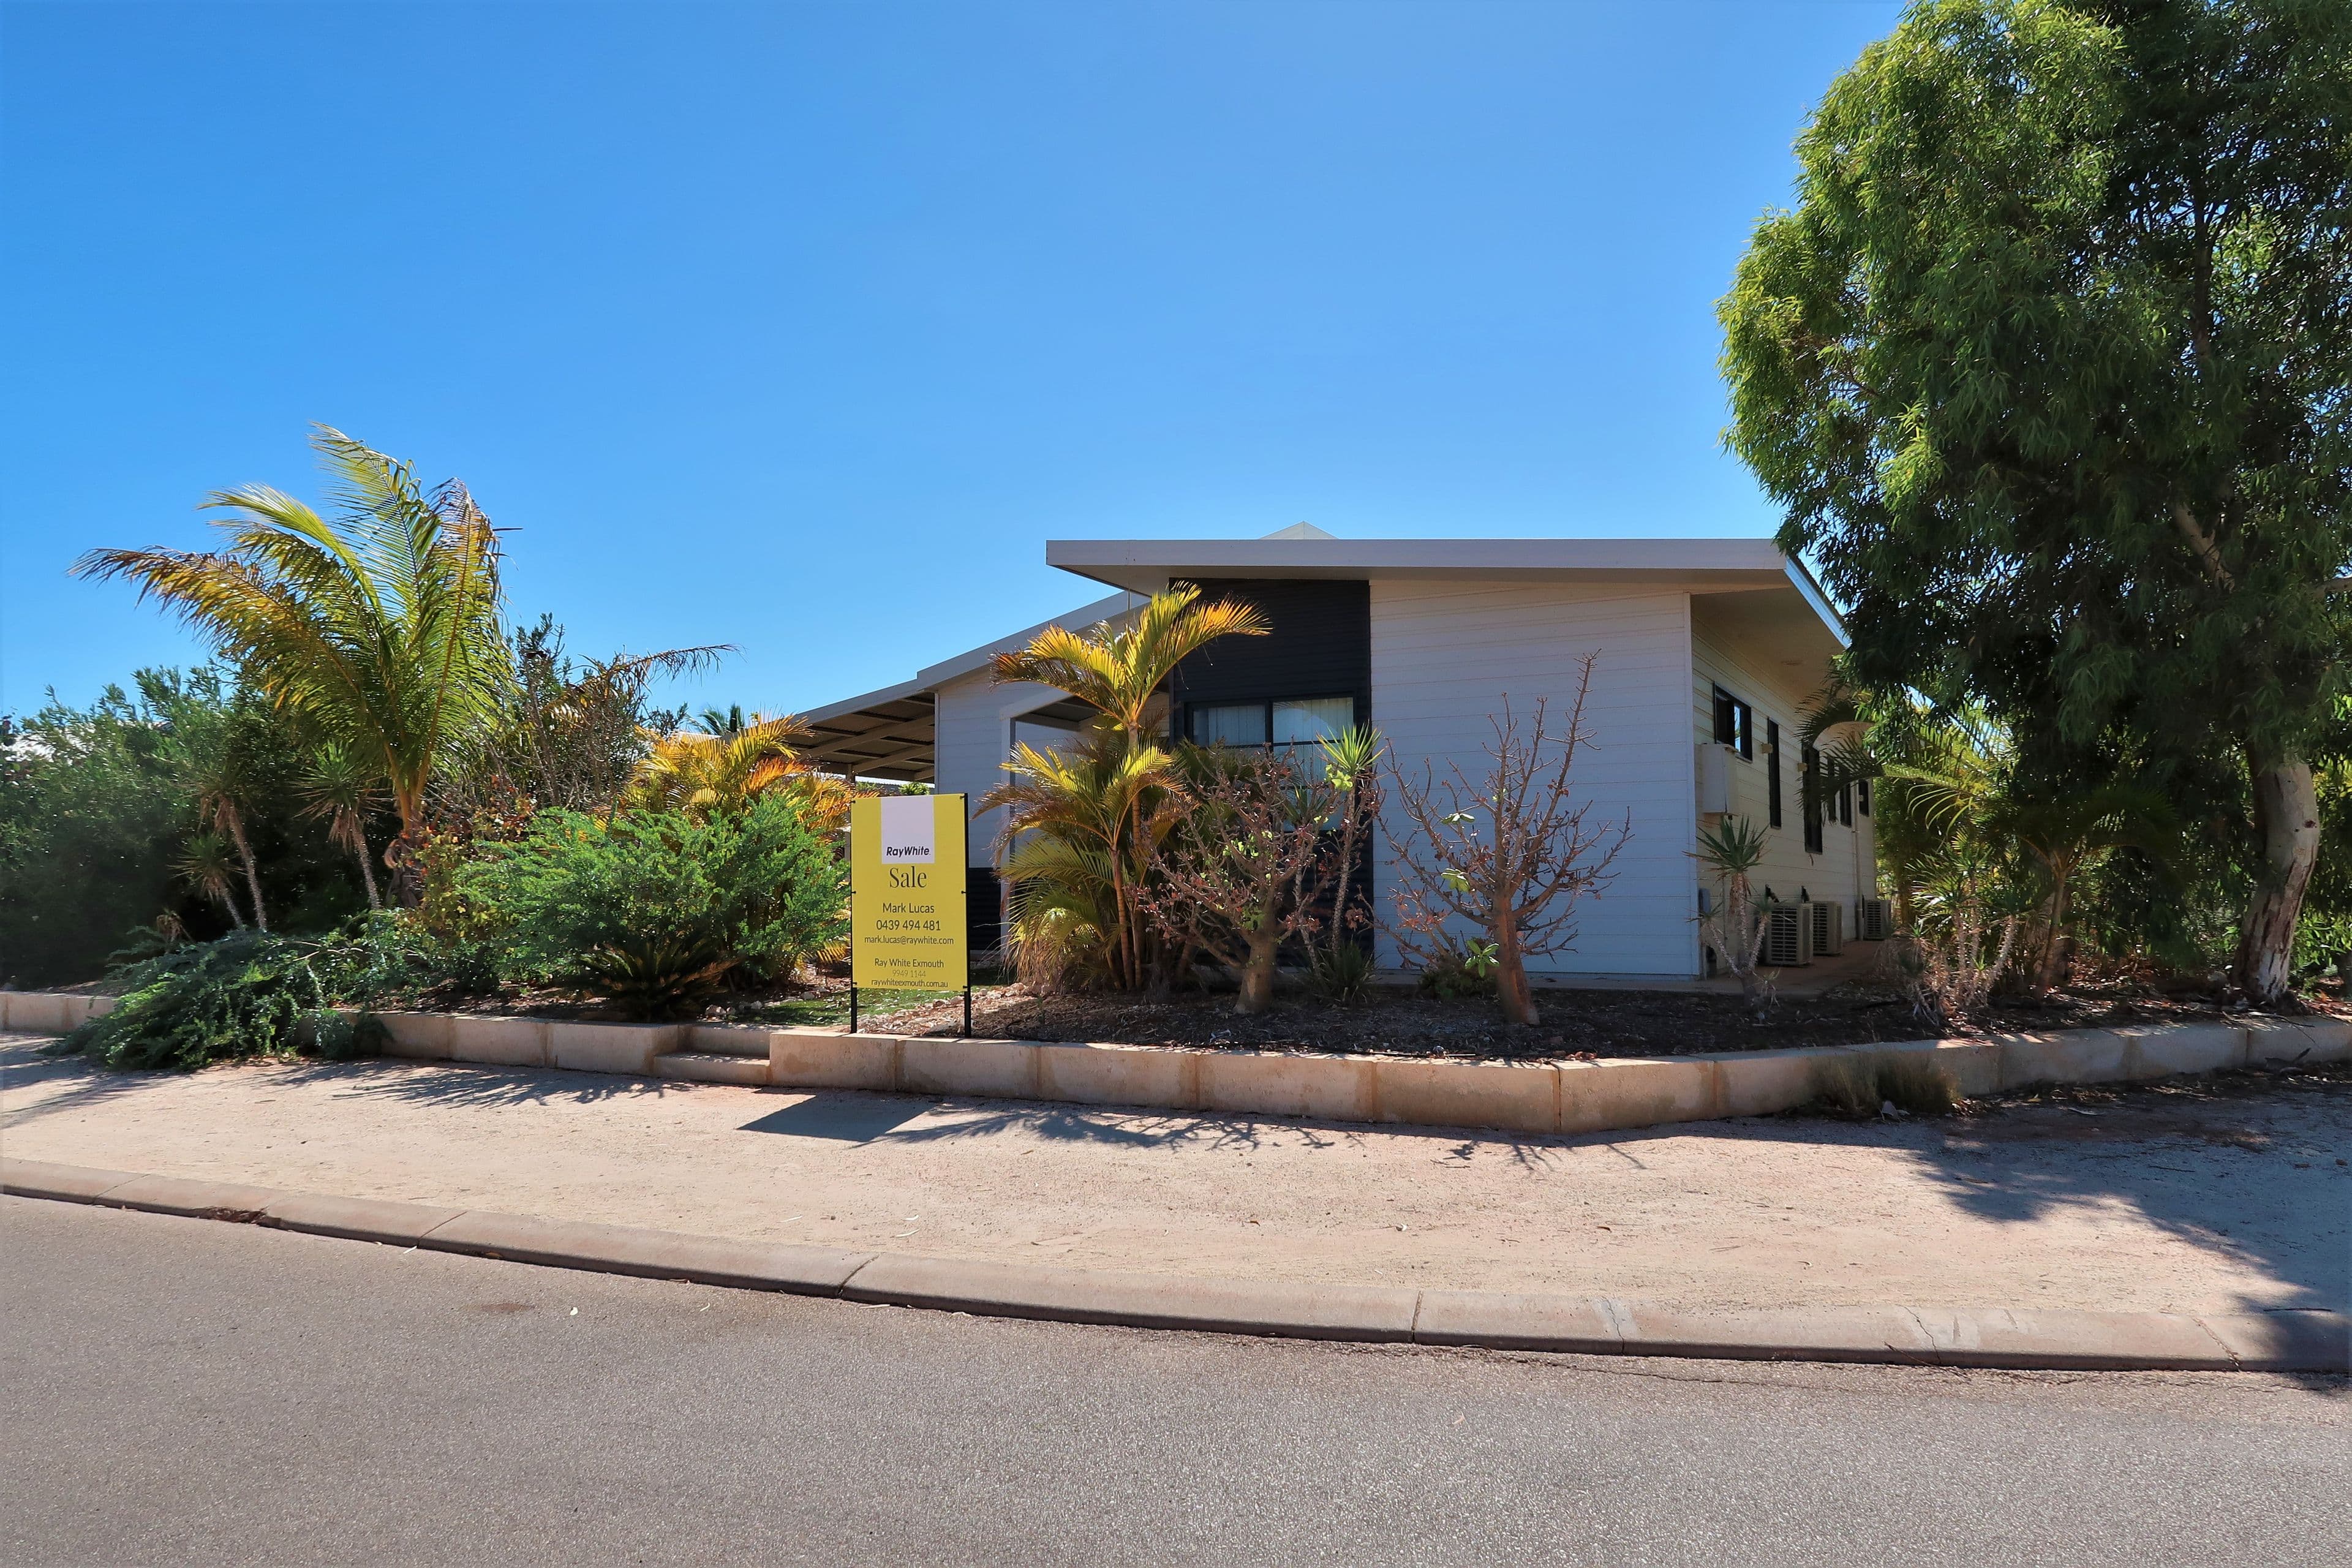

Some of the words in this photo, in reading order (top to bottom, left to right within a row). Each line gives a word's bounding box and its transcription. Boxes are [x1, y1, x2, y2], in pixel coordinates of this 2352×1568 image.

[889, 865, 927, 888] Sale
[883, 902, 907, 913] Mark
[909, 903, 935, 913] Lucas
[876, 919, 900, 930] 0439
[902, 920, 921, 930] 494
[923, 920, 941, 931] 481
[864, 935, 954, 945] mark.lucas@raywhite.com
[875, 958, 888, 967] Ray
[889, 959, 911, 967] White
[913, 959, 944, 968] Exmouth
[871, 978, 948, 988] raywhiteexmouth.com.au
